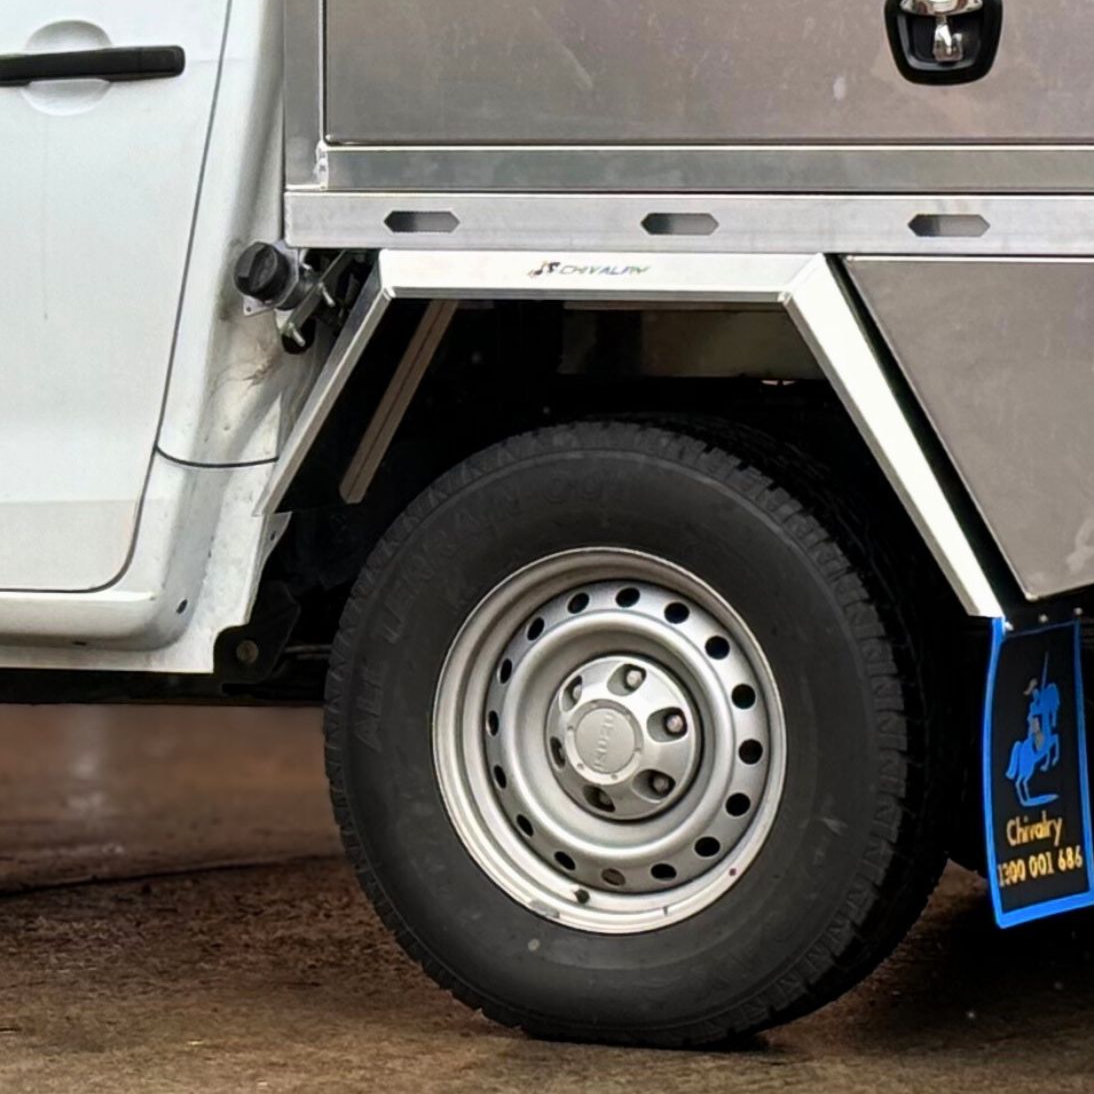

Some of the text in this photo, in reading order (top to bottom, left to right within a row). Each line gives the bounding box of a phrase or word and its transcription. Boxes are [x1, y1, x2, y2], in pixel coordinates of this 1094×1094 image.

[1006, 810, 1062, 846] Chivalry
[1029, 851, 1054, 878] 001
[1058, 845, 1083, 871] 686
